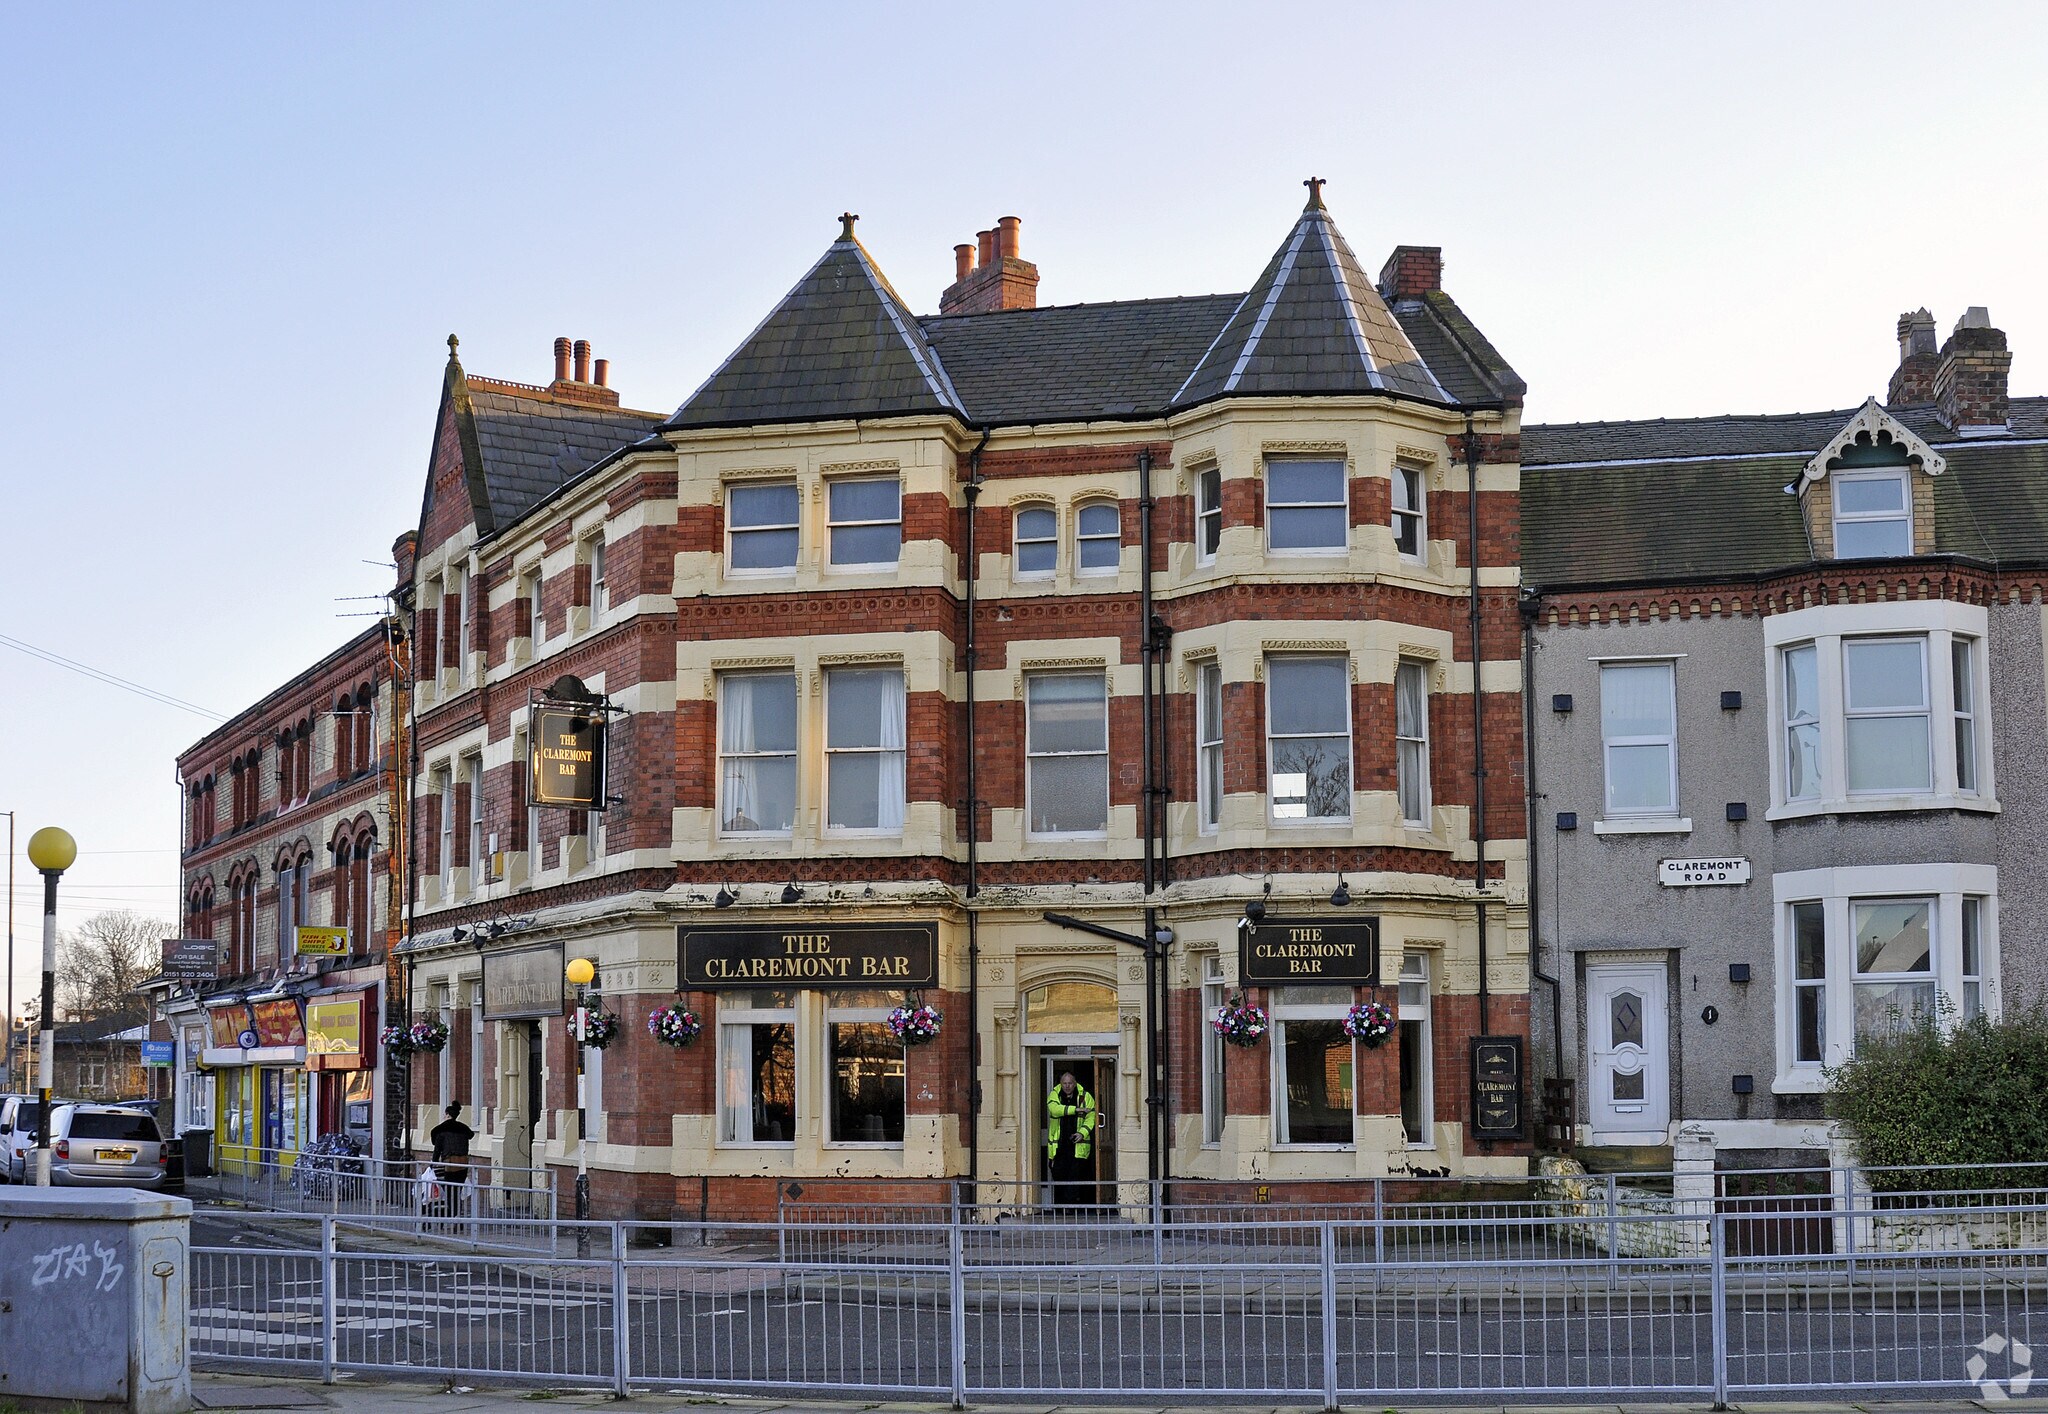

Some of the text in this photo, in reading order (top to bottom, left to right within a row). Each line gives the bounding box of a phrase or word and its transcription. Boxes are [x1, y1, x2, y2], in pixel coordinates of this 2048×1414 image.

[559, 734, 577, 746] THE
[543, 748, 592, 762] CLAREMONT
[559, 763, 576, 775] BAR
[1668, 862, 1741, 870] CLAREMONT
[1684, 873, 1727, 881] ROAD
[1289, 928, 1322, 942] THE
[782, 935, 830, 954] THE
[1255, 943, 1356, 958] CLAREMONT
[705, 956, 910, 978] CLAREMONT BAR
[1289, 960, 1322, 973] BAR
[1477, 1082, 1516, 1091] CLAREMONT
[1490, 1094, 1504, 1103] BAR
